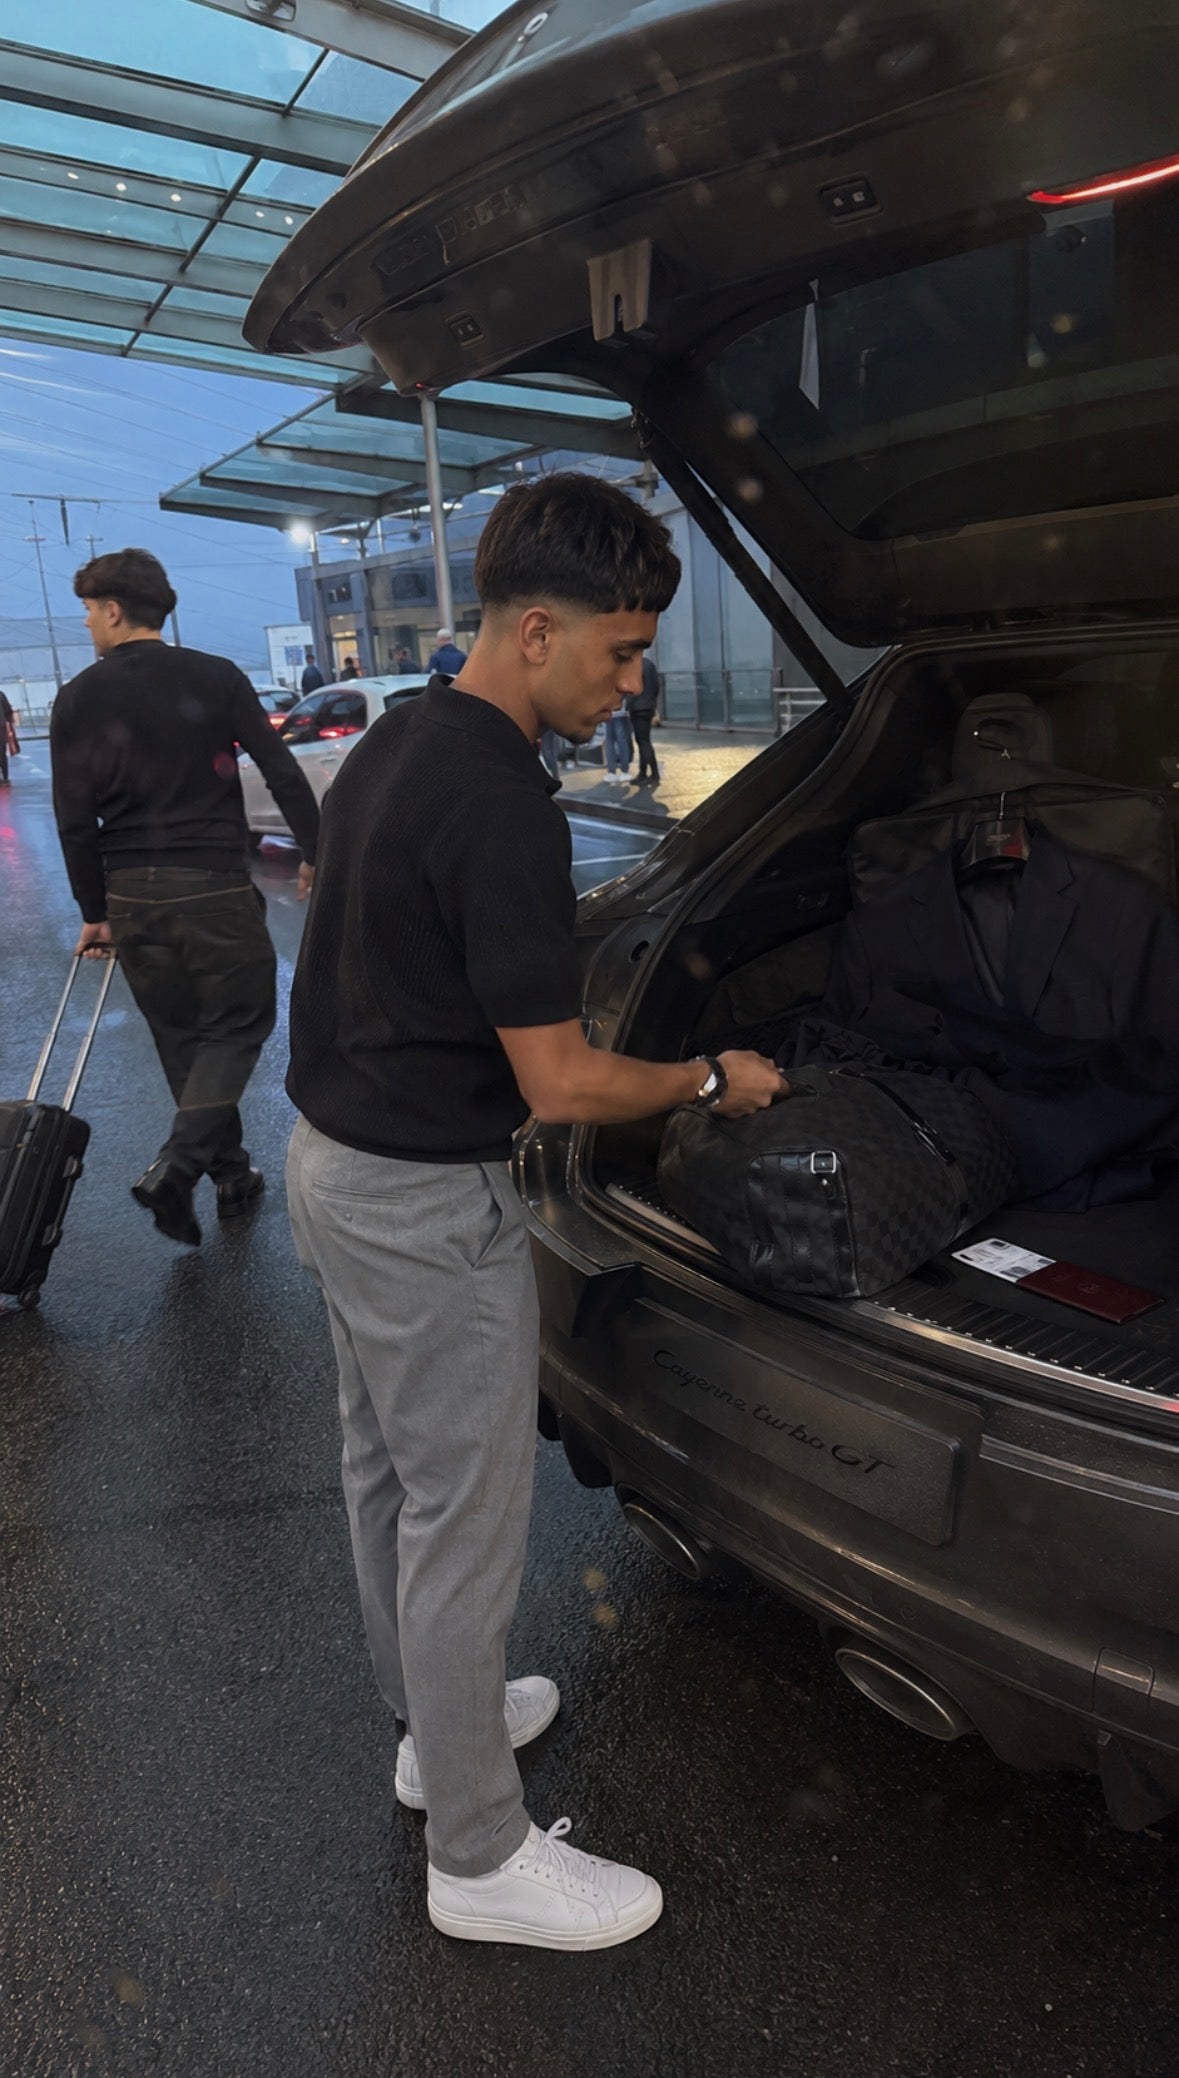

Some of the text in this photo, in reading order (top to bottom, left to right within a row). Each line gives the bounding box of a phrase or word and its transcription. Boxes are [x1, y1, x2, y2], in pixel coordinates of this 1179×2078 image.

[653, 1349, 896, 1475] Cayenne turbo GT
